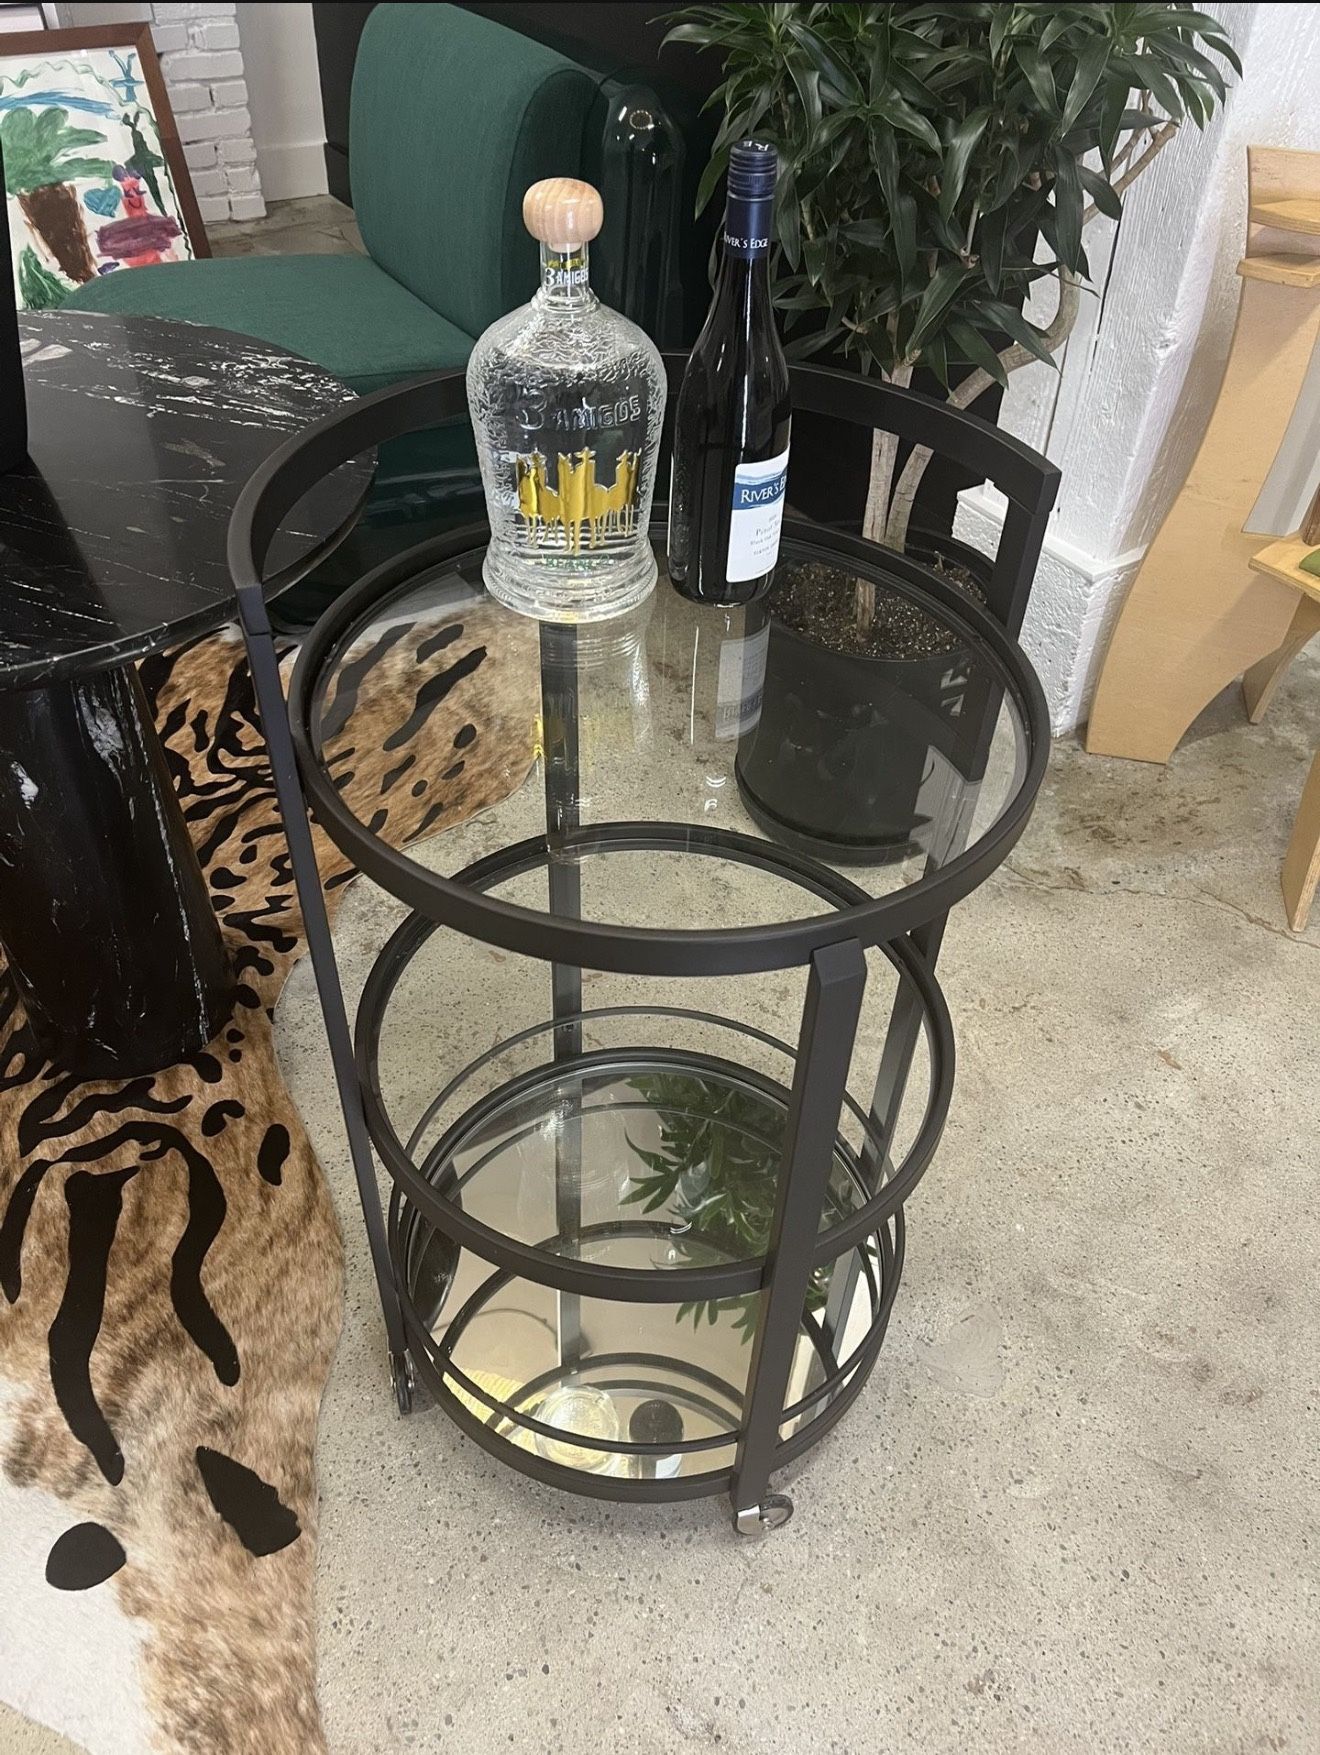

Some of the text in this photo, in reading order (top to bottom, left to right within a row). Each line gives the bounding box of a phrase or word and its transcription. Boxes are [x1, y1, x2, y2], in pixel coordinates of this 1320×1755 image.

[750, 237, 769, 249] EDGE
[544, 267, 589, 287] 3 AMIGOS
[519, 388, 641, 431] 3 AMIGOS
[740, 482, 779, 504] RIVER'S
